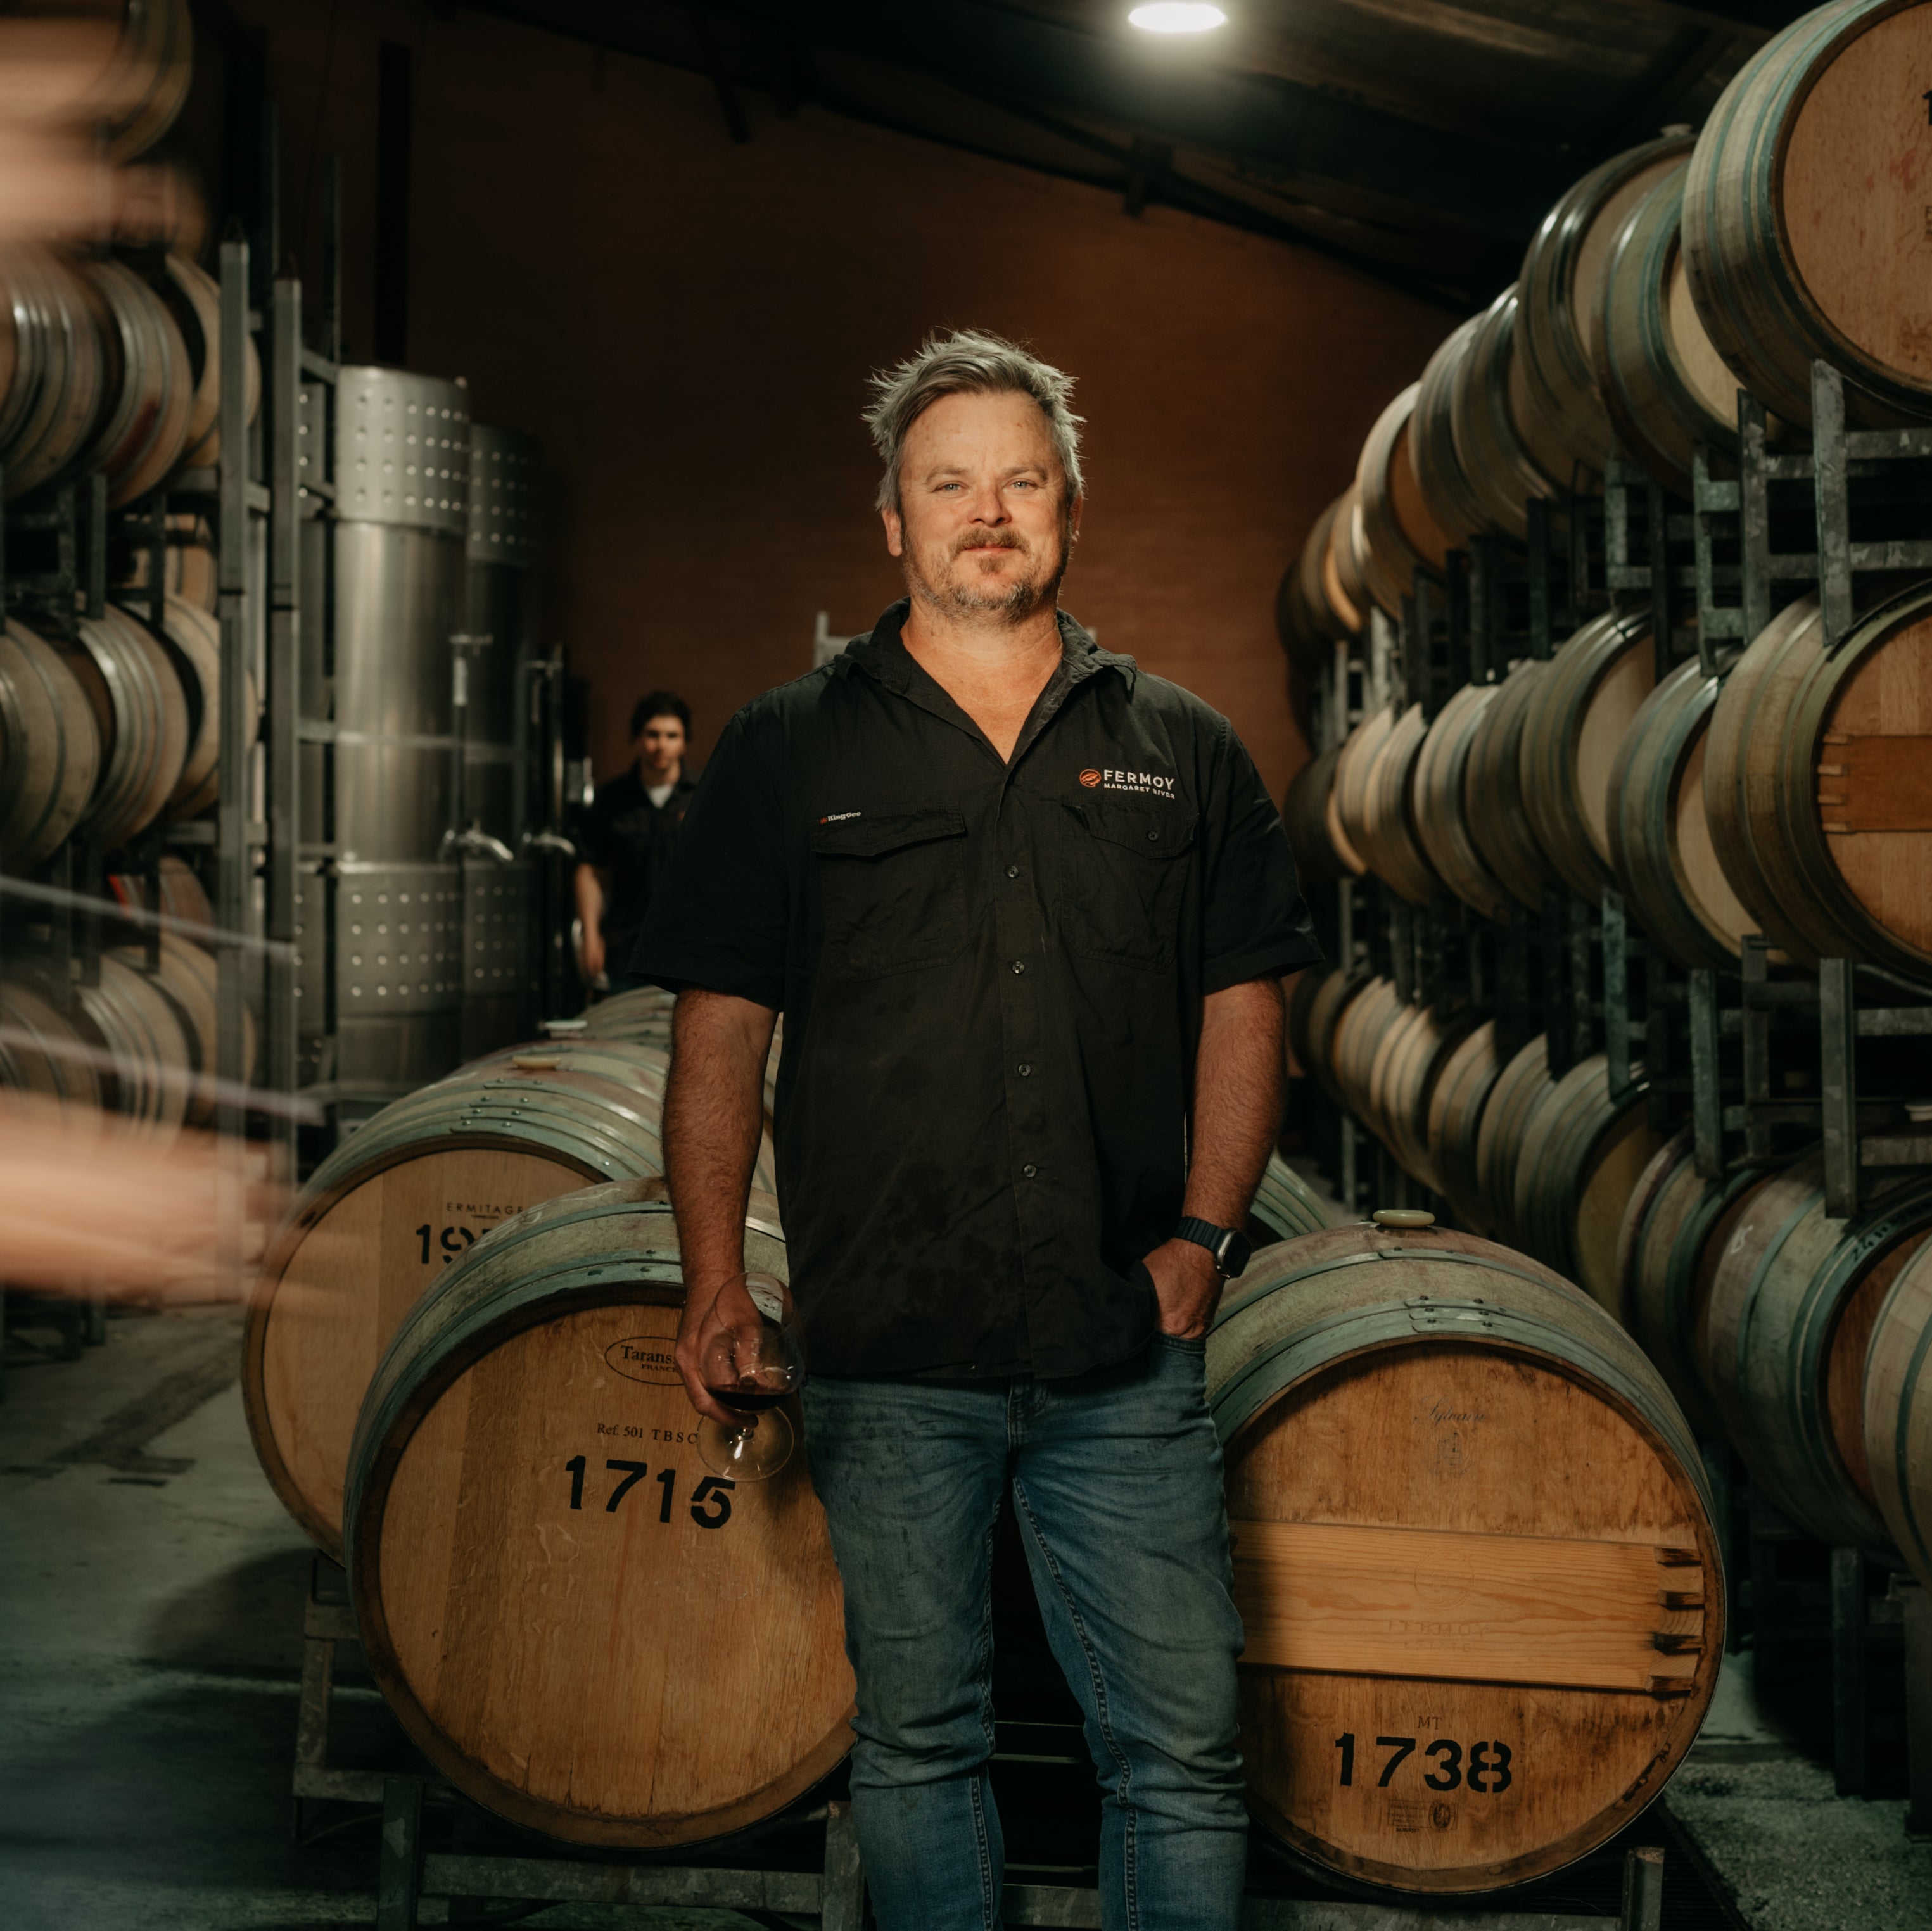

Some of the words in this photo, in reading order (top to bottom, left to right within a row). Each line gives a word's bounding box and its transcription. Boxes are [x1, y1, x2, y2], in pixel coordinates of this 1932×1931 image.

[1103, 769, 1175, 790] FERMOY
[1103, 783, 1150, 792] MARGARET
[1152, 788, 1175, 799] RIVER
[827, 811, 861, 821] KingGee
[416, 1224, 492, 1264] 19
[620, 1345, 677, 1364] Tarans
[597, 1422, 620, 1436] Ref.
[623, 1426, 644, 1438] 501
[565, 1455, 735, 1529] 1715
[1417, 1716, 1442, 1730] MT
[1335, 1733, 1512, 1793] 1738
